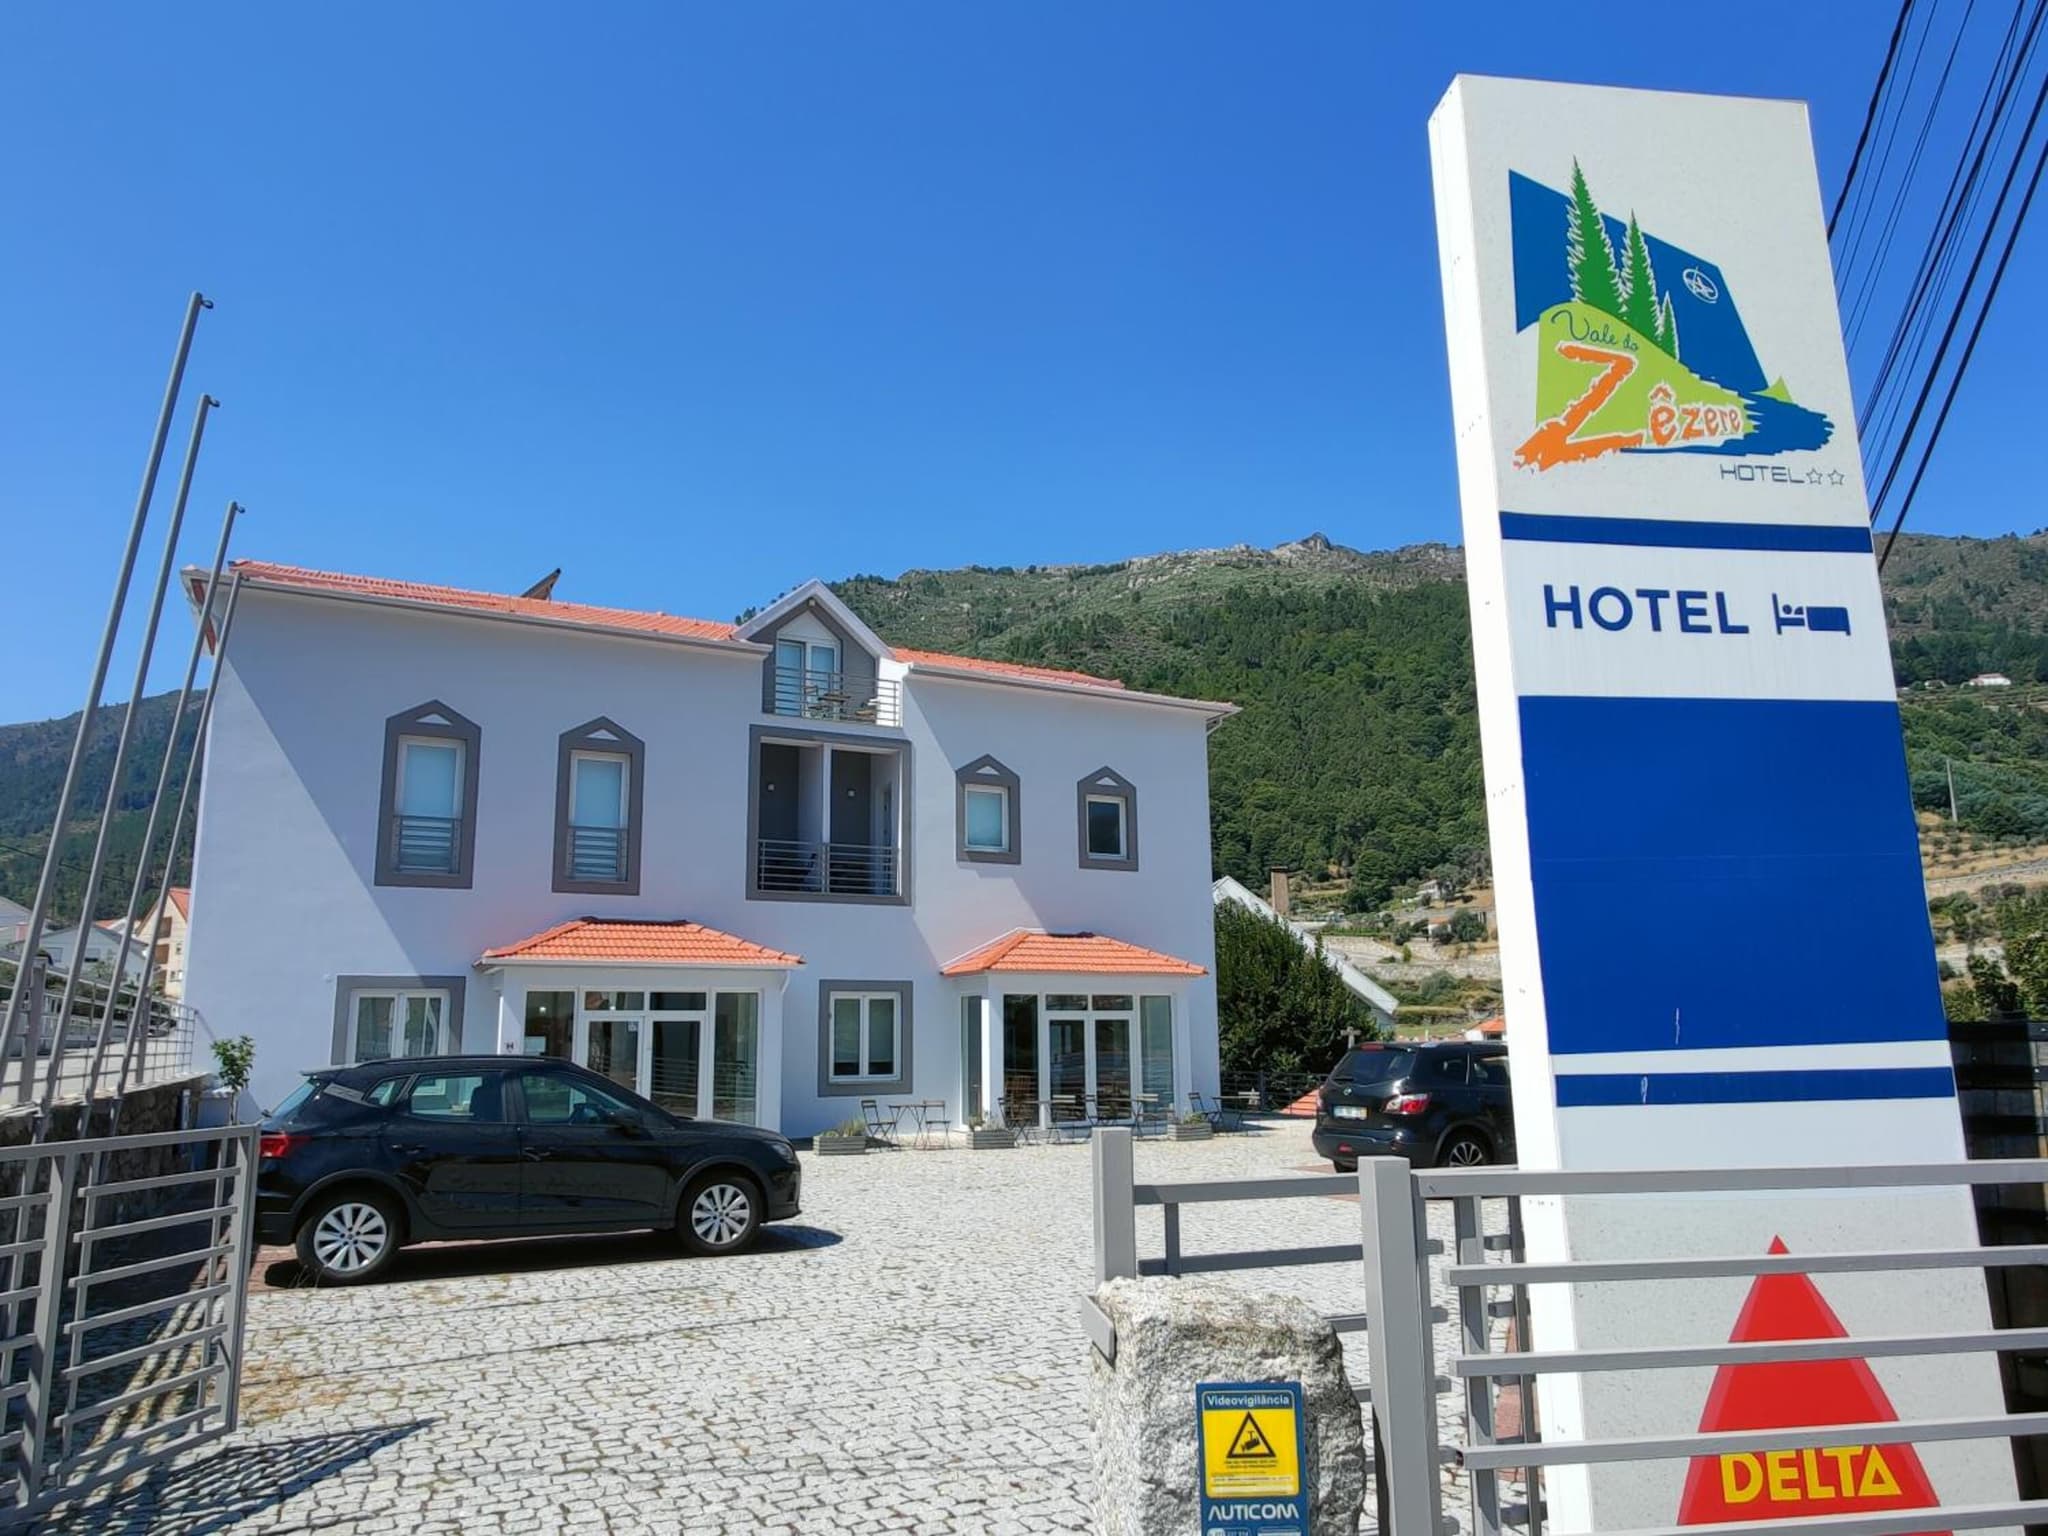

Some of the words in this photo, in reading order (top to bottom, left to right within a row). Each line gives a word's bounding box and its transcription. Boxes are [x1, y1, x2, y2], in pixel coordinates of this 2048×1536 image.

[1551, 309, 1617, 345] Vale
[1623, 333, 1639, 352] do
[1513, 343, 1741, 471] Zêzere
[1719, 463, 1805, 484] HOTEL
[1543, 584, 1750, 635] HOTEL
[1207, 1394, 1290, 1408] Videovigilância
[1720, 1445, 1902, 1504] DELTA
[1208, 1503, 1300, 1522] AUTICOM
